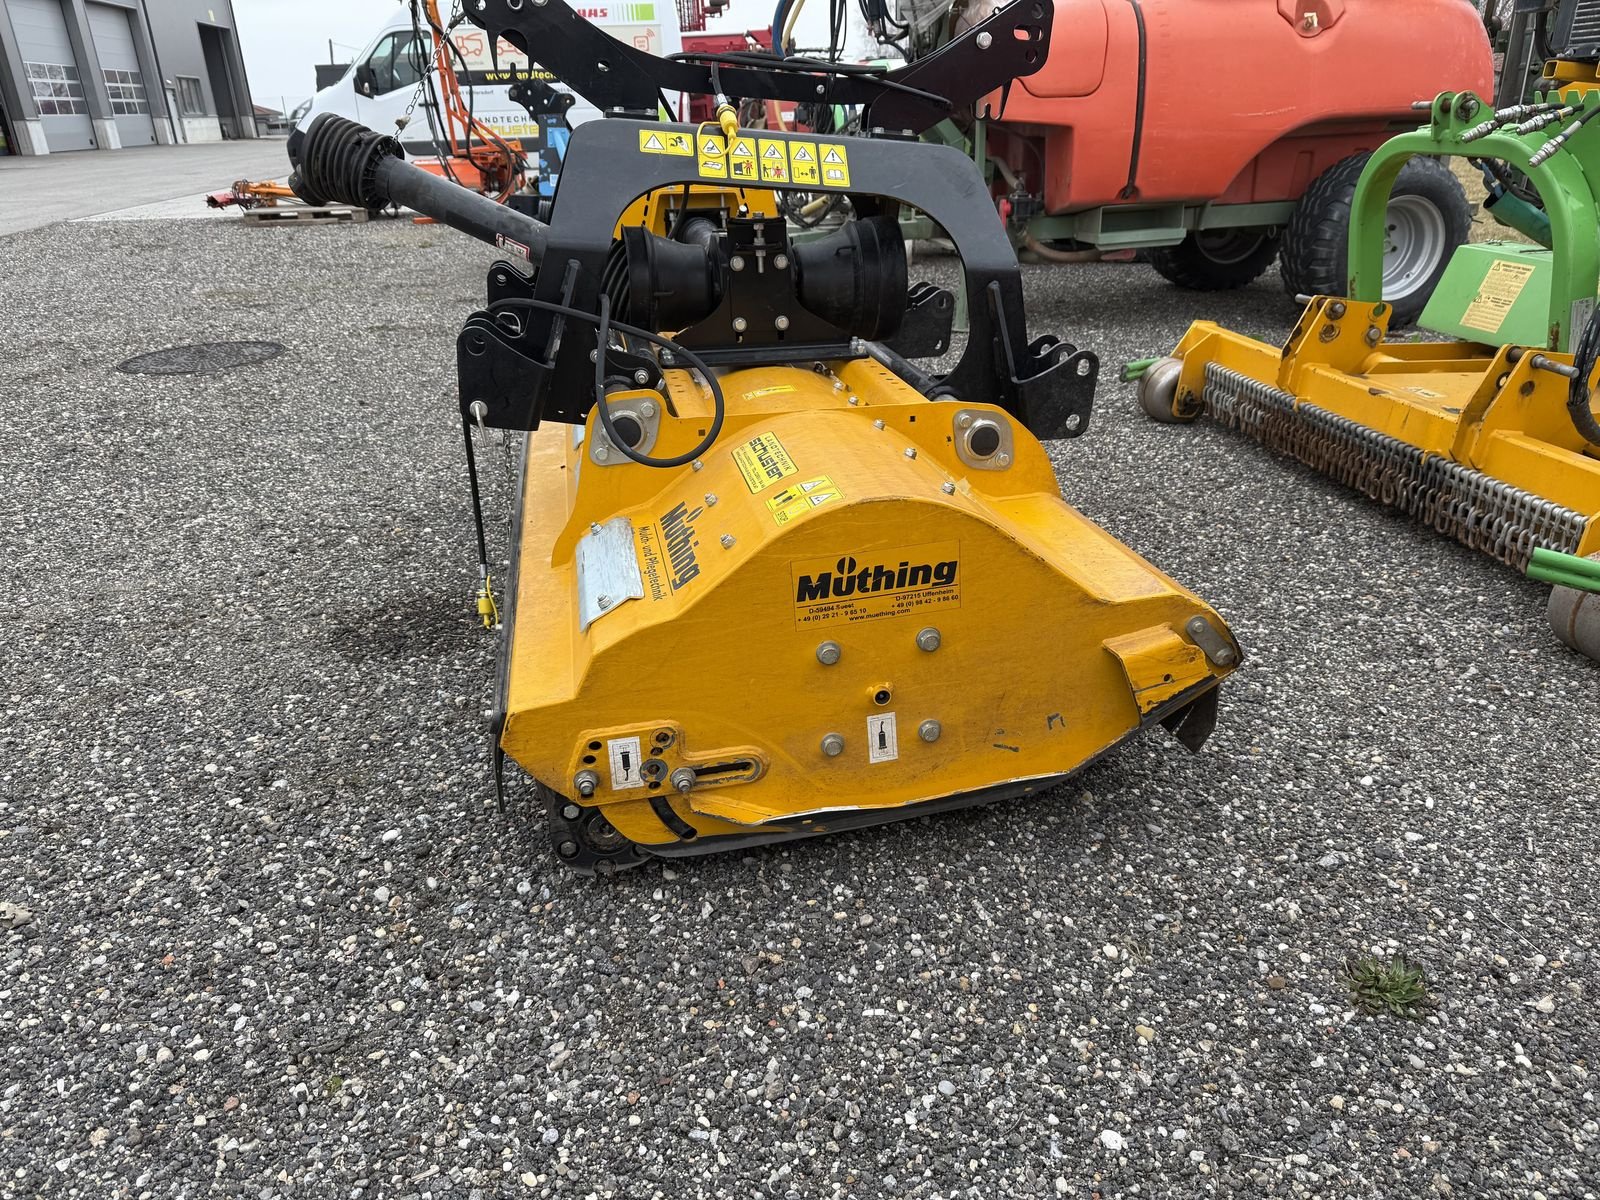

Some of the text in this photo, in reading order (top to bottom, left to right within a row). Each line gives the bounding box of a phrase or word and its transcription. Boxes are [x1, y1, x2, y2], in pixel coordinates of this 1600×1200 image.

[749, 436, 783, 479] schuster
[764, 435, 792, 472] LANDTECHNIK
[639, 525, 667, 602] Mulch- und Pflegetechnik
[660, 501, 704, 590] Müthing
[796, 556, 958, 603] Müthing
[895, 588, 954, 602] D-97215 Uffenheim
[812, 614, 821, 622] (0)
[848, 607, 911, 622] www.muething.com
